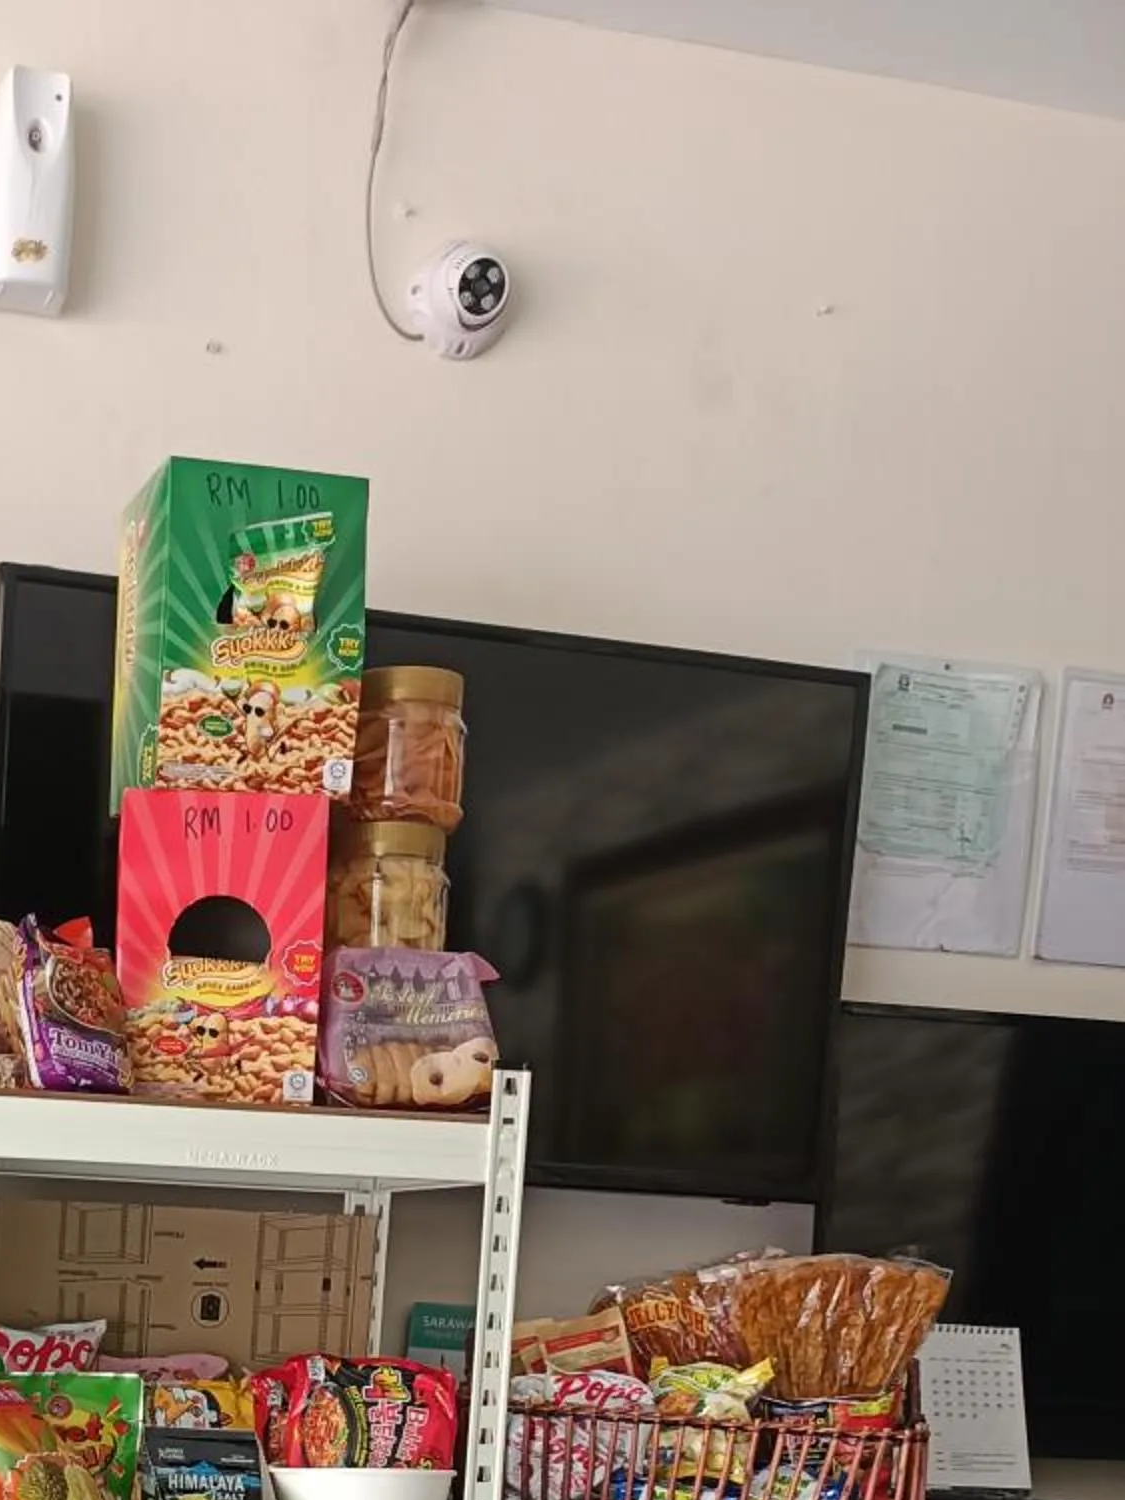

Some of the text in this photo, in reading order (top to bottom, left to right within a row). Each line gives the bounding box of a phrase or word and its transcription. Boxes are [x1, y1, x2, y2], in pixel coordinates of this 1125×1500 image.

[205, 472, 321, 511] RM 1.00
[183, 805, 294, 840] RM 1.00
[421, 1315, 473, 1329] SARAWA
[167, 1473, 246, 1492] HIMALAYA
